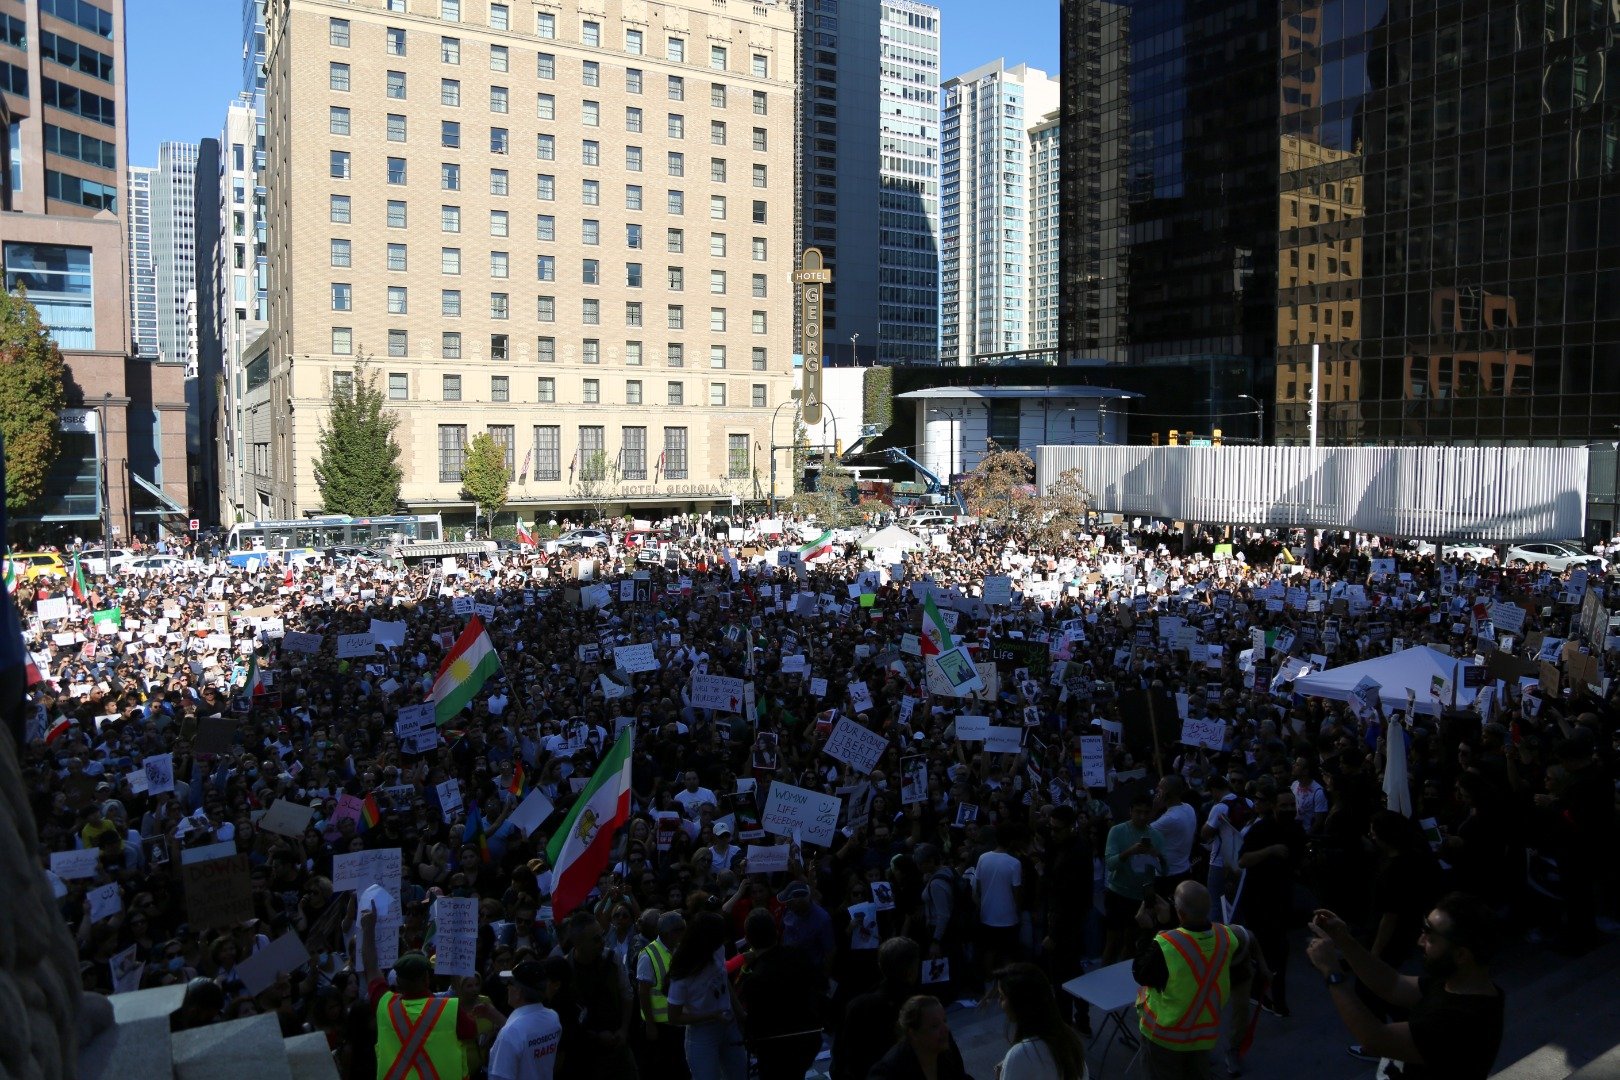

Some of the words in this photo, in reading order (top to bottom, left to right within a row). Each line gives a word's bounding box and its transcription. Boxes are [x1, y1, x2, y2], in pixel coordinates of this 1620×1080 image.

[796, 272, 827, 280] HOTEL
[805, 287, 819, 406] GEORGIA
[59, 416, 85, 424] HSBC
[621, 485, 658, 495] HOTEL
[666, 484, 719, 494] GEORGIA
[993, 649, 1014, 660] Life
[401, 721, 418, 731] IRAN
[839, 721, 859, 738] OUR
[828, 742, 839, 754] IS
[834, 731, 877, 758] LIBERTY
[775, 788, 808, 804] WOMXN
[777, 803, 798, 816] LIFE
[818, 800, 835, 814] زن
[766, 812, 804, 829] FREEDOM
[190, 857, 245, 881] DOWN
[440, 900, 472, 910] Stand
[439, 952, 450, 960] of
[528, 1031, 560, 1048] PROSECUT
